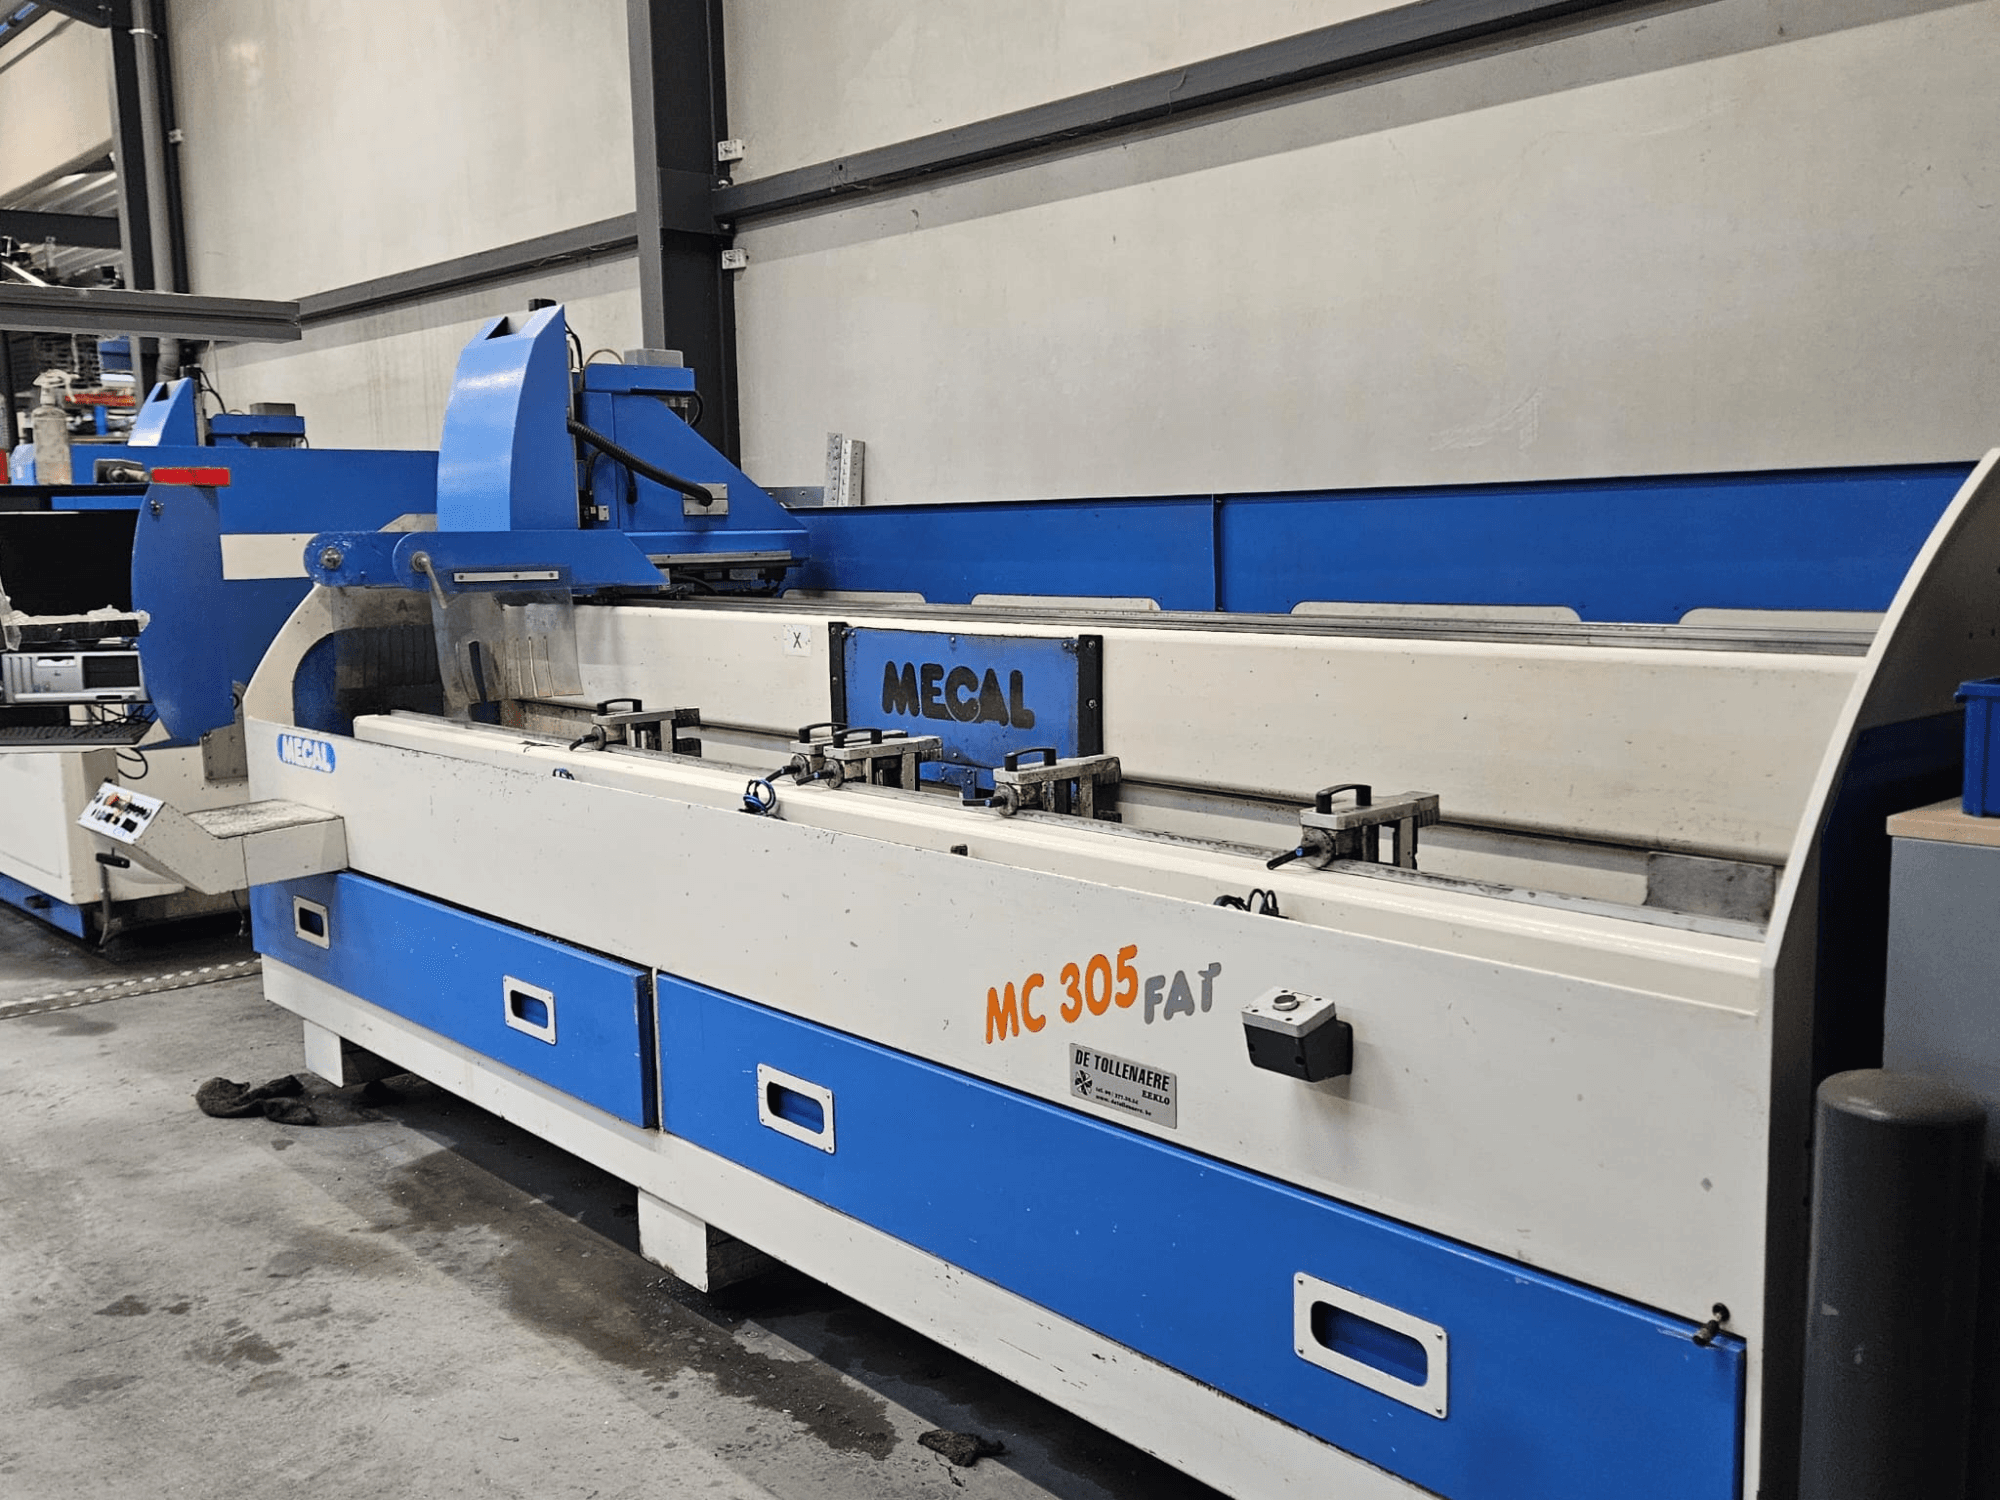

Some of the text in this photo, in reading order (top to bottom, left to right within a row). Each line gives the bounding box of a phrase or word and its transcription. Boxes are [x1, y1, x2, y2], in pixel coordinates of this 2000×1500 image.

[793, 631, 802, 649] X
[882, 660, 1035, 729] MECAL
[280, 735, 335, 773] MECAL
[986, 944, 1222, 1044] MC 305 FAT
[1075, 1049, 1170, 1092] DE TOLLENAERE
[1141, 1089, 1170, 1105] EEKLO
